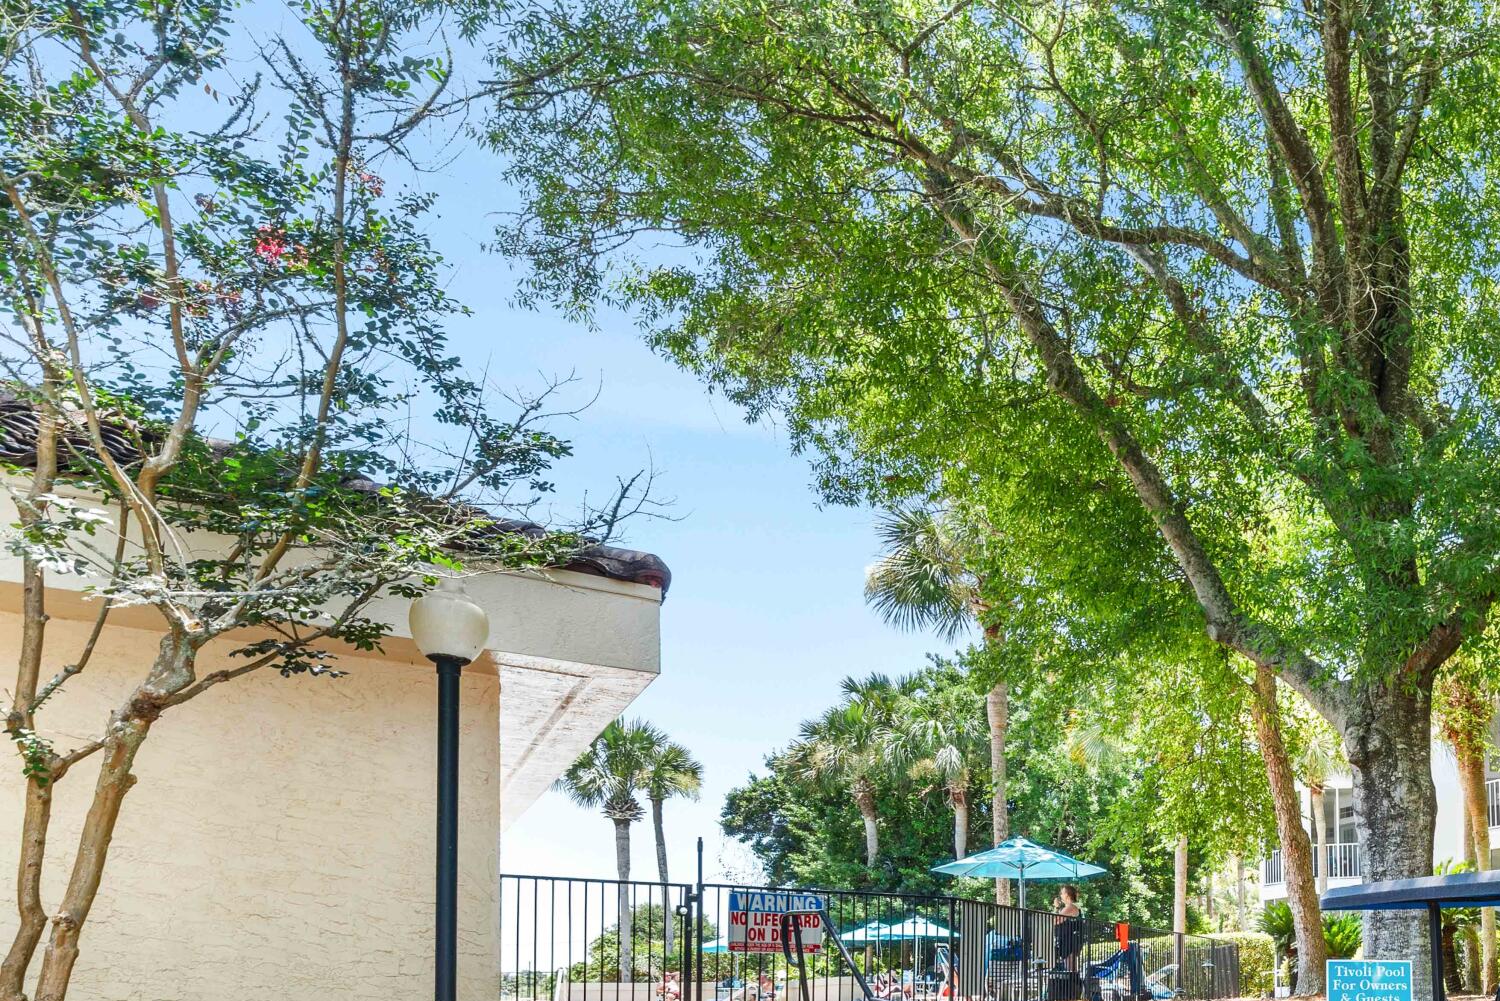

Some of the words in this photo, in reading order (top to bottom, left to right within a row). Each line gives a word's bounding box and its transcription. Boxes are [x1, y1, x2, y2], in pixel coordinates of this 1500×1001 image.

[737, 893, 817, 912] WARNING
[731, 912, 747, 925] NO
[748, 928, 765, 941] ON
[1334, 966, 1372, 977] Tivoli
[1376, 966, 1405, 977] Pool
[1333, 980, 1356, 990] For
[1360, 980, 1407, 990] Owners
